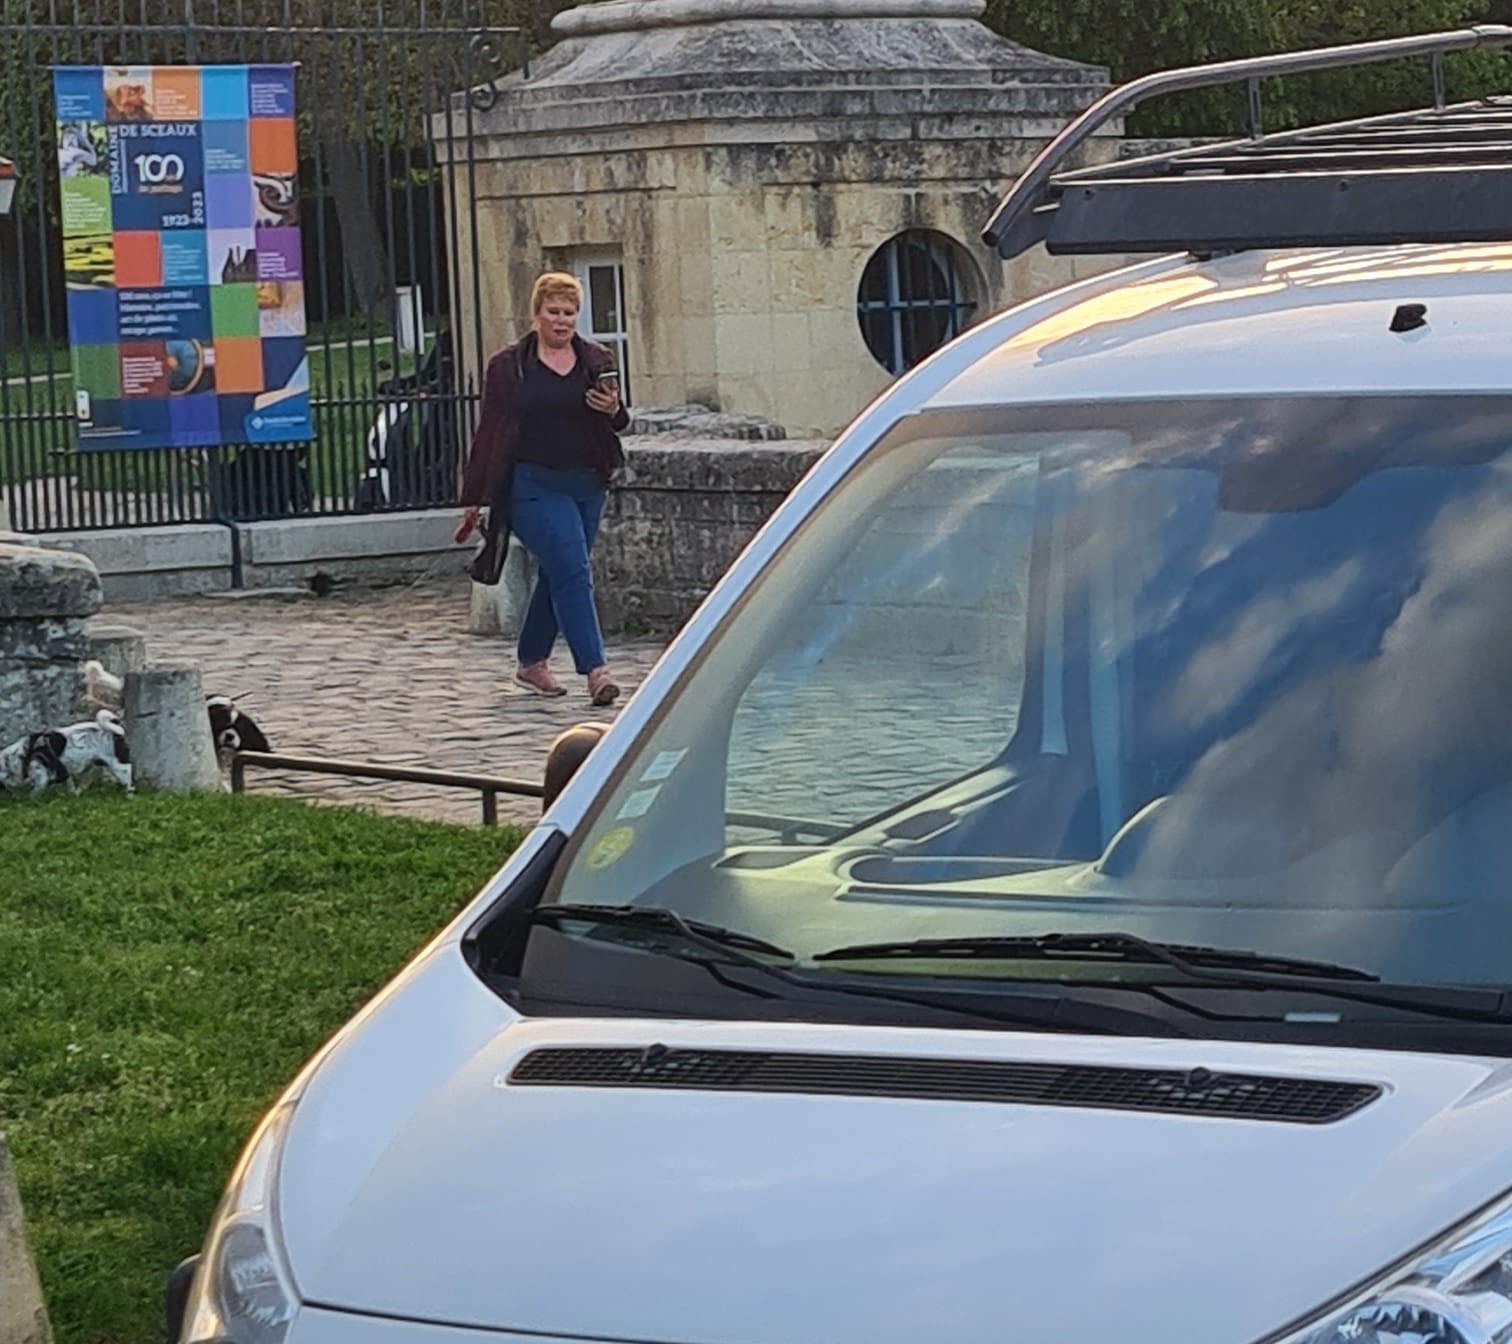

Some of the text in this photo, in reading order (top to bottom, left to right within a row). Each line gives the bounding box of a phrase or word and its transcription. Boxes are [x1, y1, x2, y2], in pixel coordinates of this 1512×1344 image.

[120, 123, 198, 137] DE SCEAUX
[108, 125, 121, 194] DOMAINE
[134, 154, 185, 183] 100
